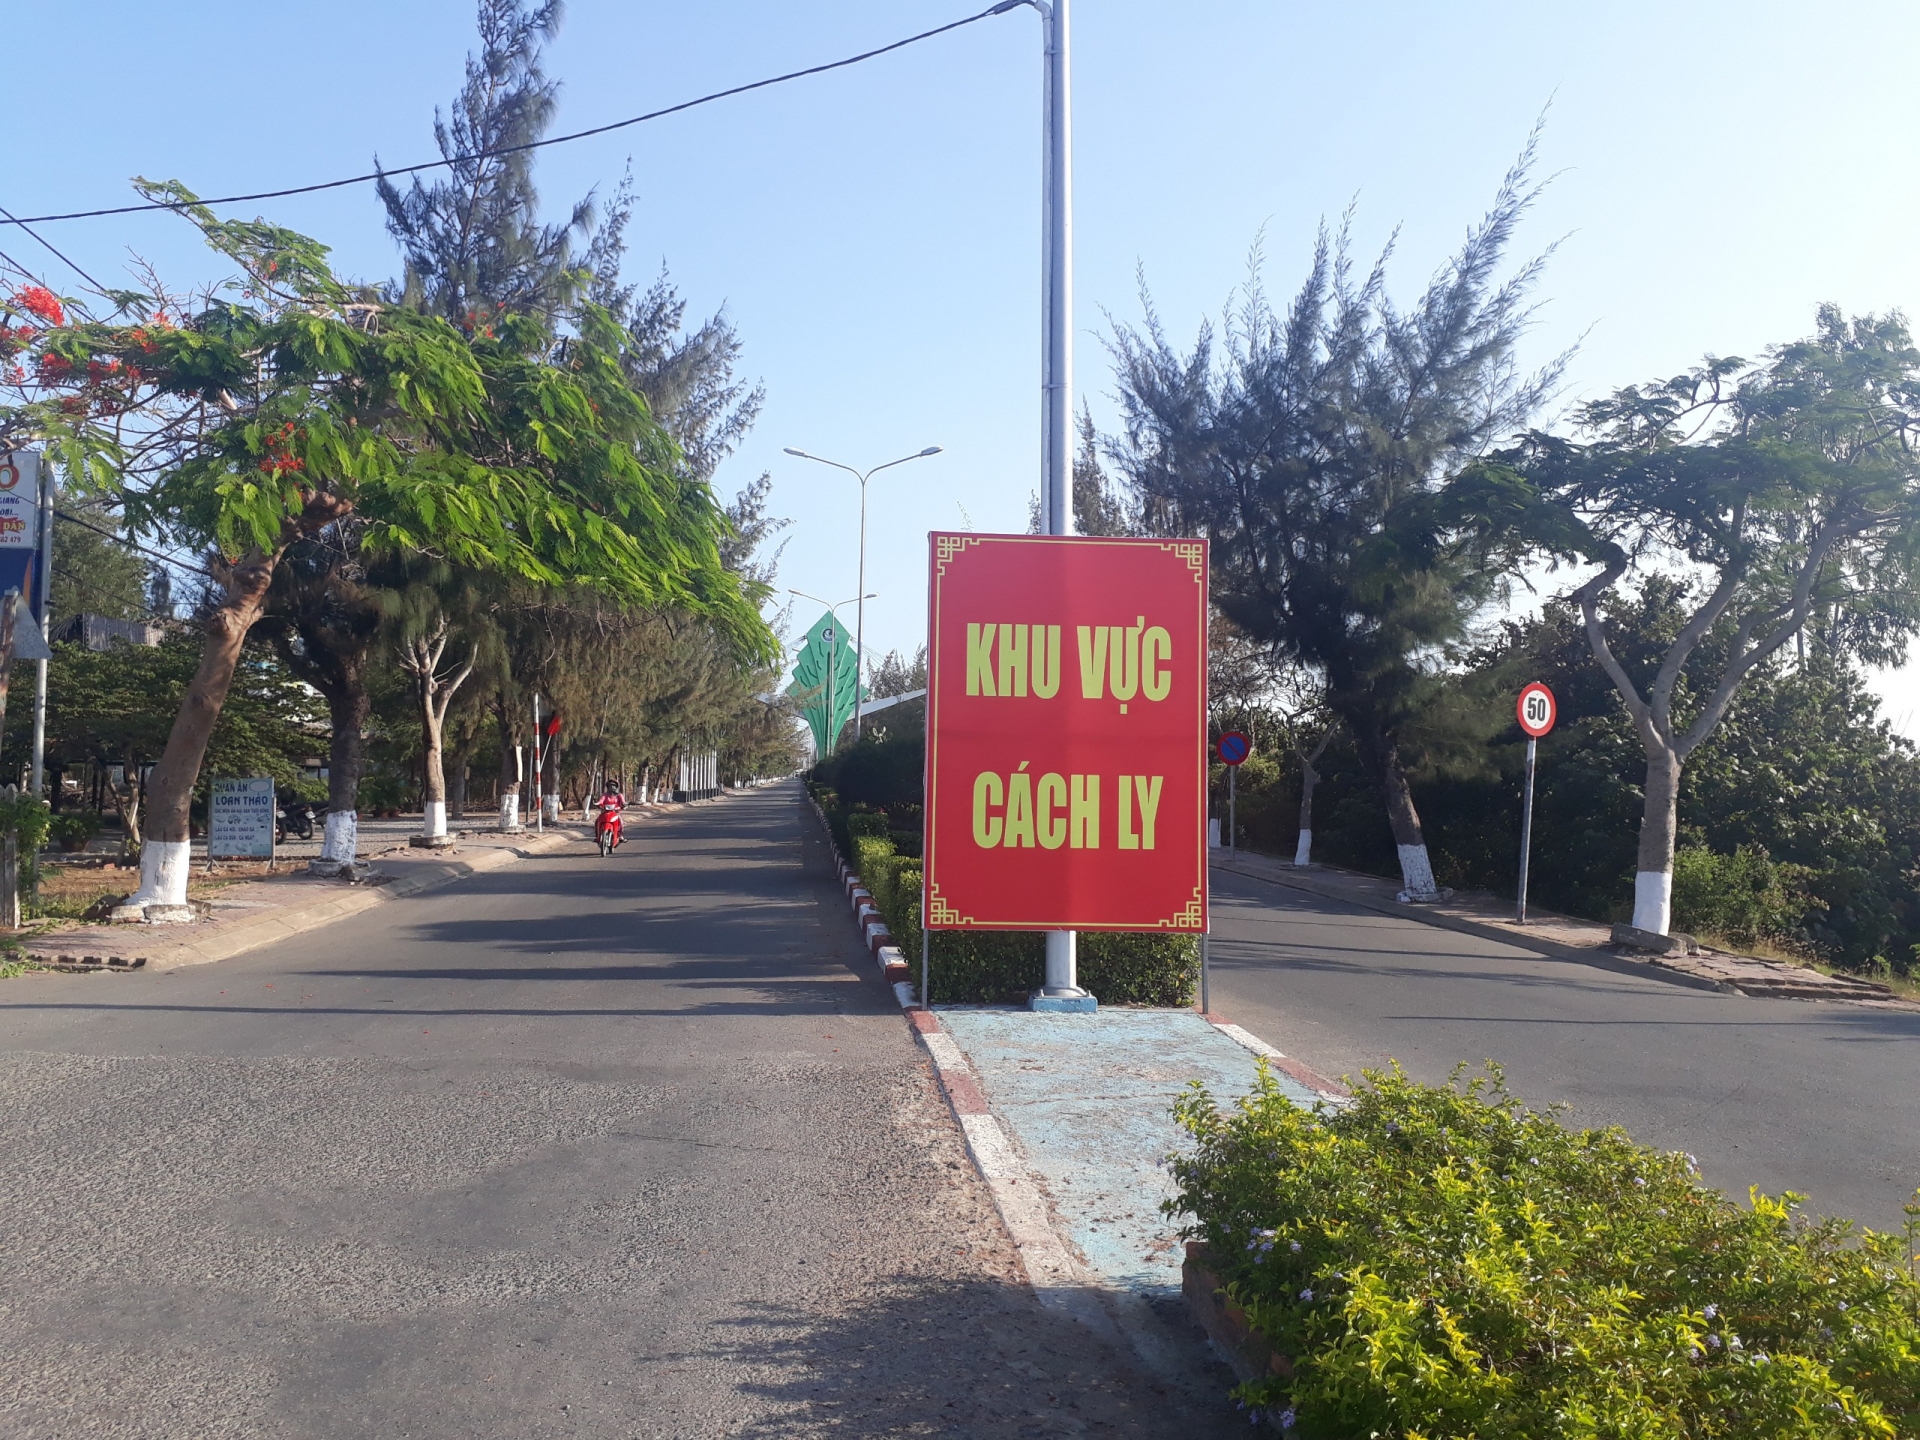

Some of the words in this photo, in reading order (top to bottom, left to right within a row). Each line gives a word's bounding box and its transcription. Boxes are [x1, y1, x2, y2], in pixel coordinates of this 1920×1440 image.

[966, 622, 1061, 699] KHU
[1076, 615, 1172, 714] VỰC
[1527, 697, 1545, 721] 50
[215, 796, 240, 806] LOAN
[243, 792, 268, 806] THẢO
[972, 760, 1100, 849] CÁCH
[1118, 775, 1164, 850] LY
